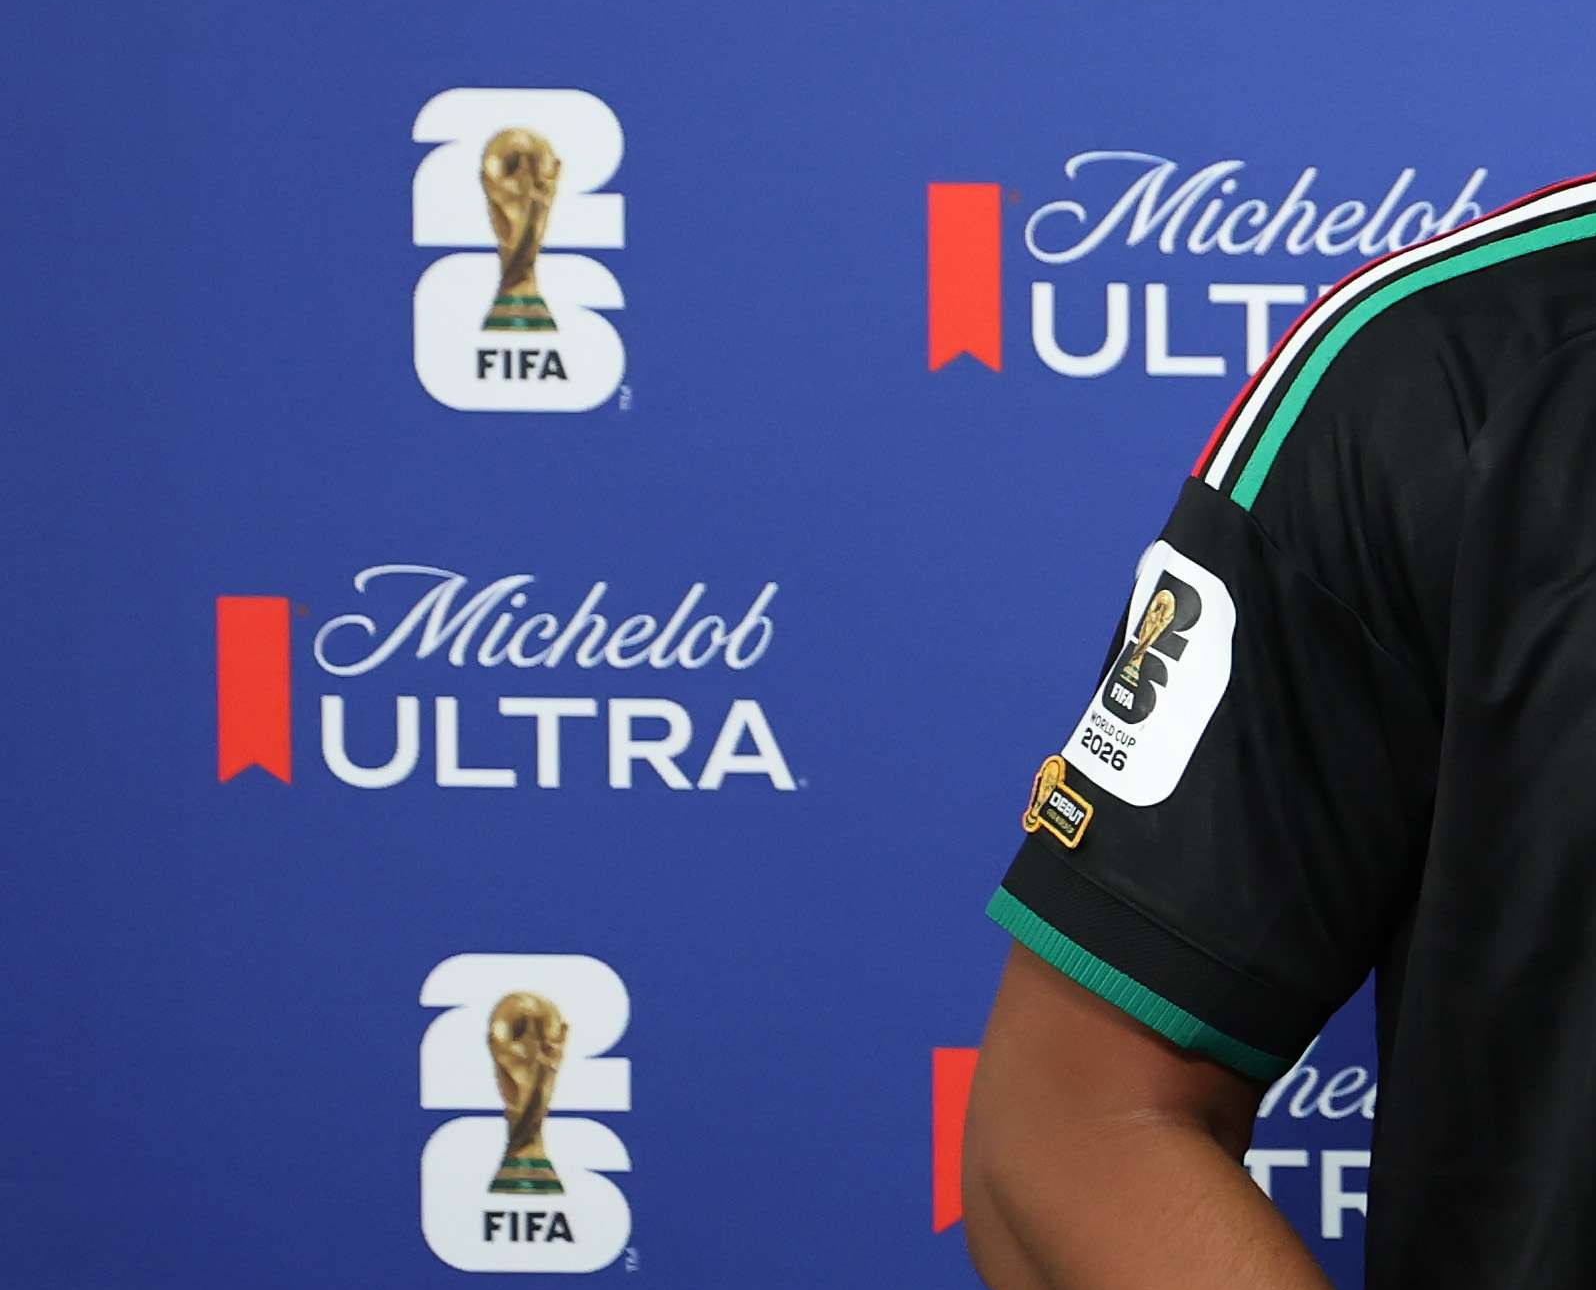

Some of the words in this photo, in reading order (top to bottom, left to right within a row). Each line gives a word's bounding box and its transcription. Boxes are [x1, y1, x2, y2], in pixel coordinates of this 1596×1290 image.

[1032, 282, 1328, 378] ULT
[478, 350, 567, 379] FIFA
[314, 565, 778, 676] Michelob
[1110, 682, 1135, 710] FIFA
[321, 695, 797, 791] ULTRA
[1081, 727, 1128, 771] 2026
[1090, 710, 1115, 737] WORLD
[1115, 729, 1137, 749] CUP
[1048, 791, 1085, 825] DEBUT
[485, 1212, 573, 1242] FIFA
